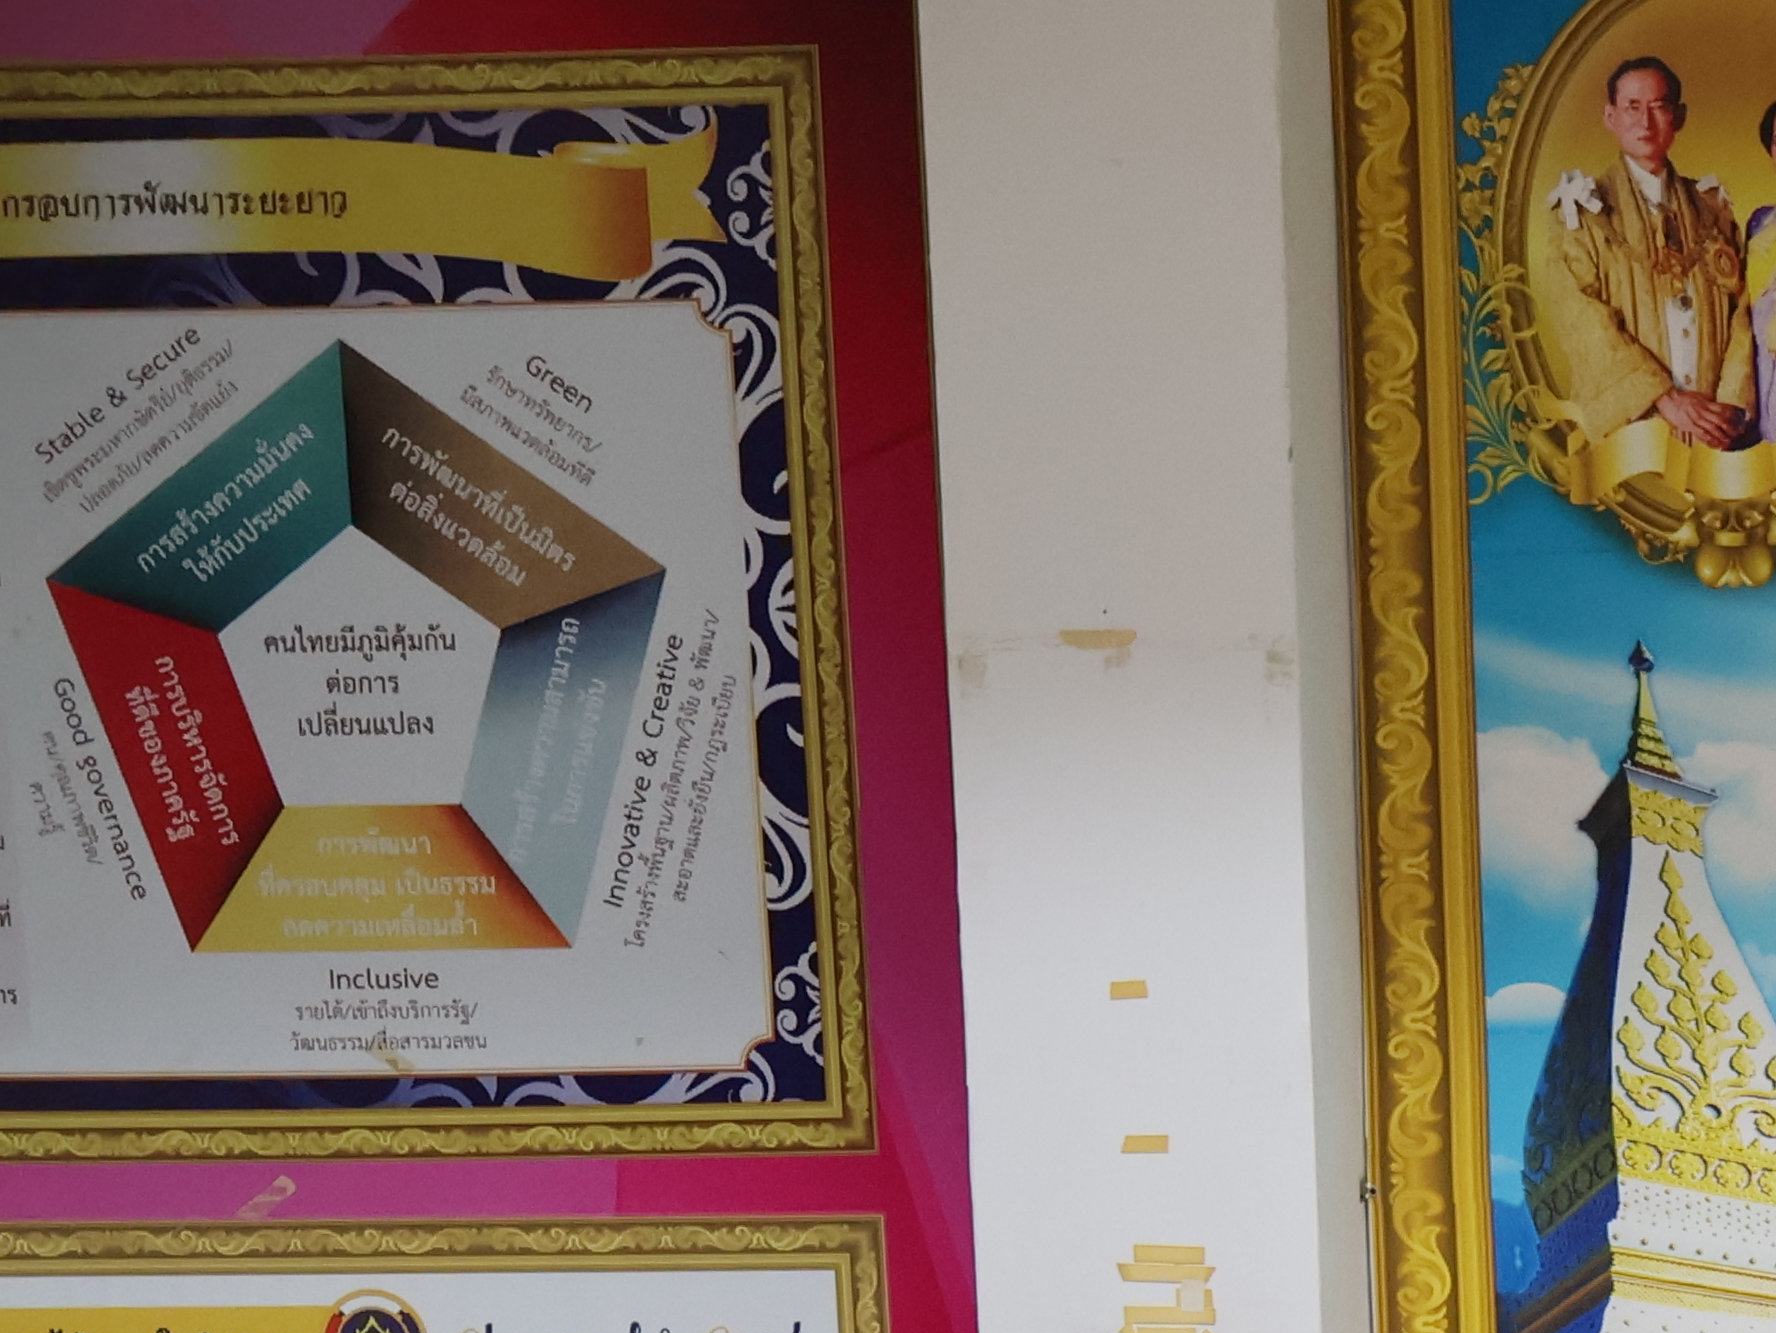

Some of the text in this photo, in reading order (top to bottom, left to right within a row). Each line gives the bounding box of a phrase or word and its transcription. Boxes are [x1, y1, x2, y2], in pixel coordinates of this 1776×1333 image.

[35, 327, 201, 464] Stable & Secure
[526, 355, 593, 414] Green
[137, 423, 316, 573] การสร้างความมั่นคง
[182, 478, 313, 583] ให้กับประเทศ
[381, 427, 577, 572] การพัฒนาที่เป็นมิตร
[389, 481, 527, 586] ต่อสิ่งแวดล้อม
[262, 622, 457, 660] คนไทยมีภูมิคุ้มกัน
[325, 668, 401, 697] ต่อการ
[125, 685, 201, 843] ที่ดีของภาครัฐ
[155, 655, 240, 846] การบริหารจัดการ
[297, 703, 436, 741] เปลี่ยนแปลง
[602, 633, 684, 908] Innovative & Creative
[54, 677, 147, 901] Good governance
[396, 866, 497, 896] เป็นธรรม
[328, 967, 440, 990] Inclusive
